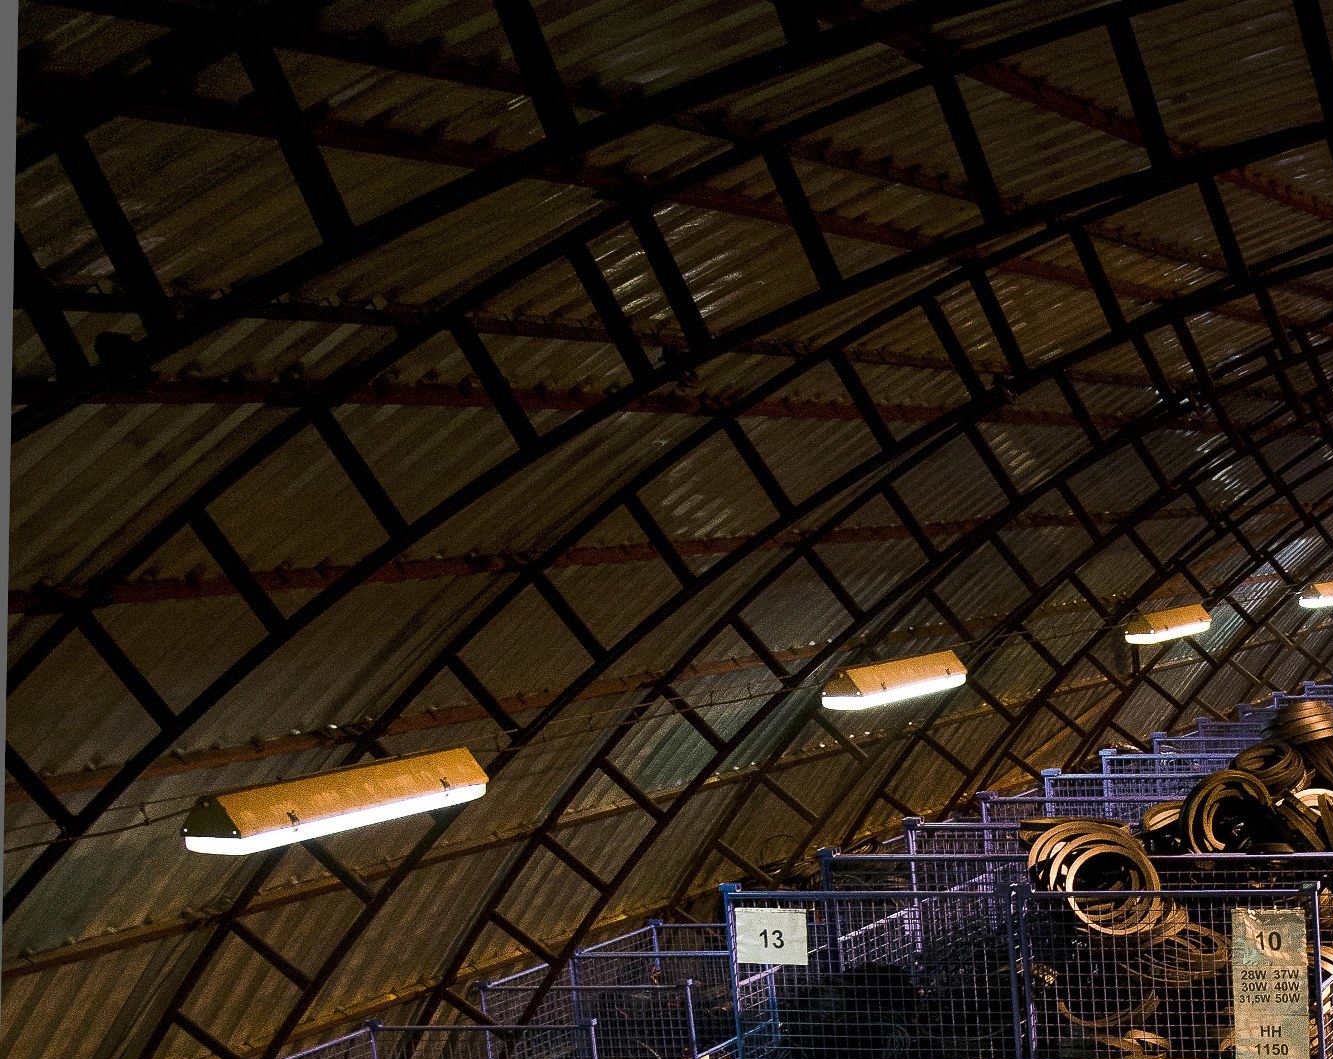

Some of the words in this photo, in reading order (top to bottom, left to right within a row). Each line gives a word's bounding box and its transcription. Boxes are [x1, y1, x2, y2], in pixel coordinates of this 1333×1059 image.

[760, 929, 785, 949] 13
[1256, 932, 1281, 951] 10
[1241, 970, 1266, 979] 28W
[1274, 970, 1298, 979] 37W
[1242, 982, 1266, 991] 30W
[1275, 982, 1299, 991] 40W
[1276, 994, 1299, 1003] 50W
[1261, 1026, 1281, 1037] HH
[1255, 1044, 1288, 1056] 1150
